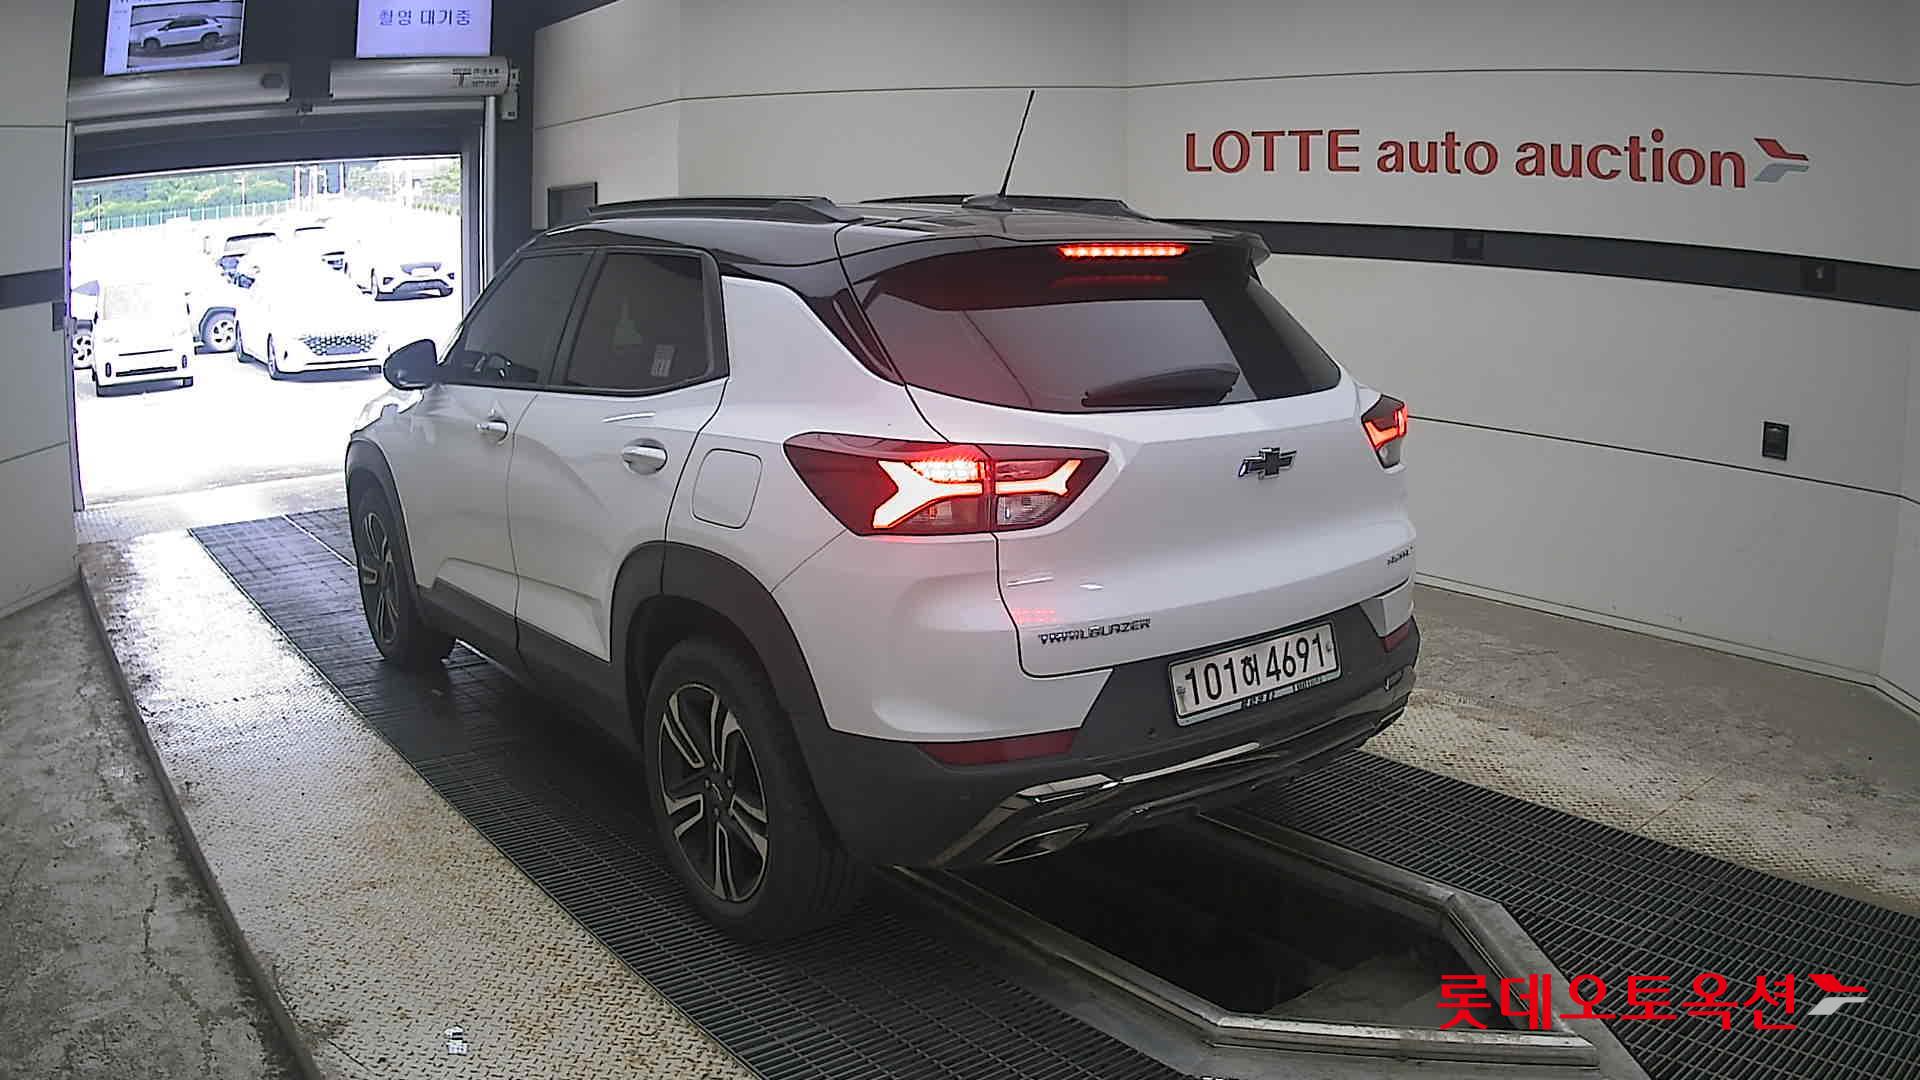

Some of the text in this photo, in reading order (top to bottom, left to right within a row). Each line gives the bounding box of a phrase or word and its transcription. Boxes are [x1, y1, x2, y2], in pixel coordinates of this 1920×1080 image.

[420, 8, 471, 26] 대기중
[1186, 128, 1746, 188] LOTTE auto auction
[1038, 618, 1151, 645] TRAILBLAZER
[1266, 632, 1325, 681] 4691
